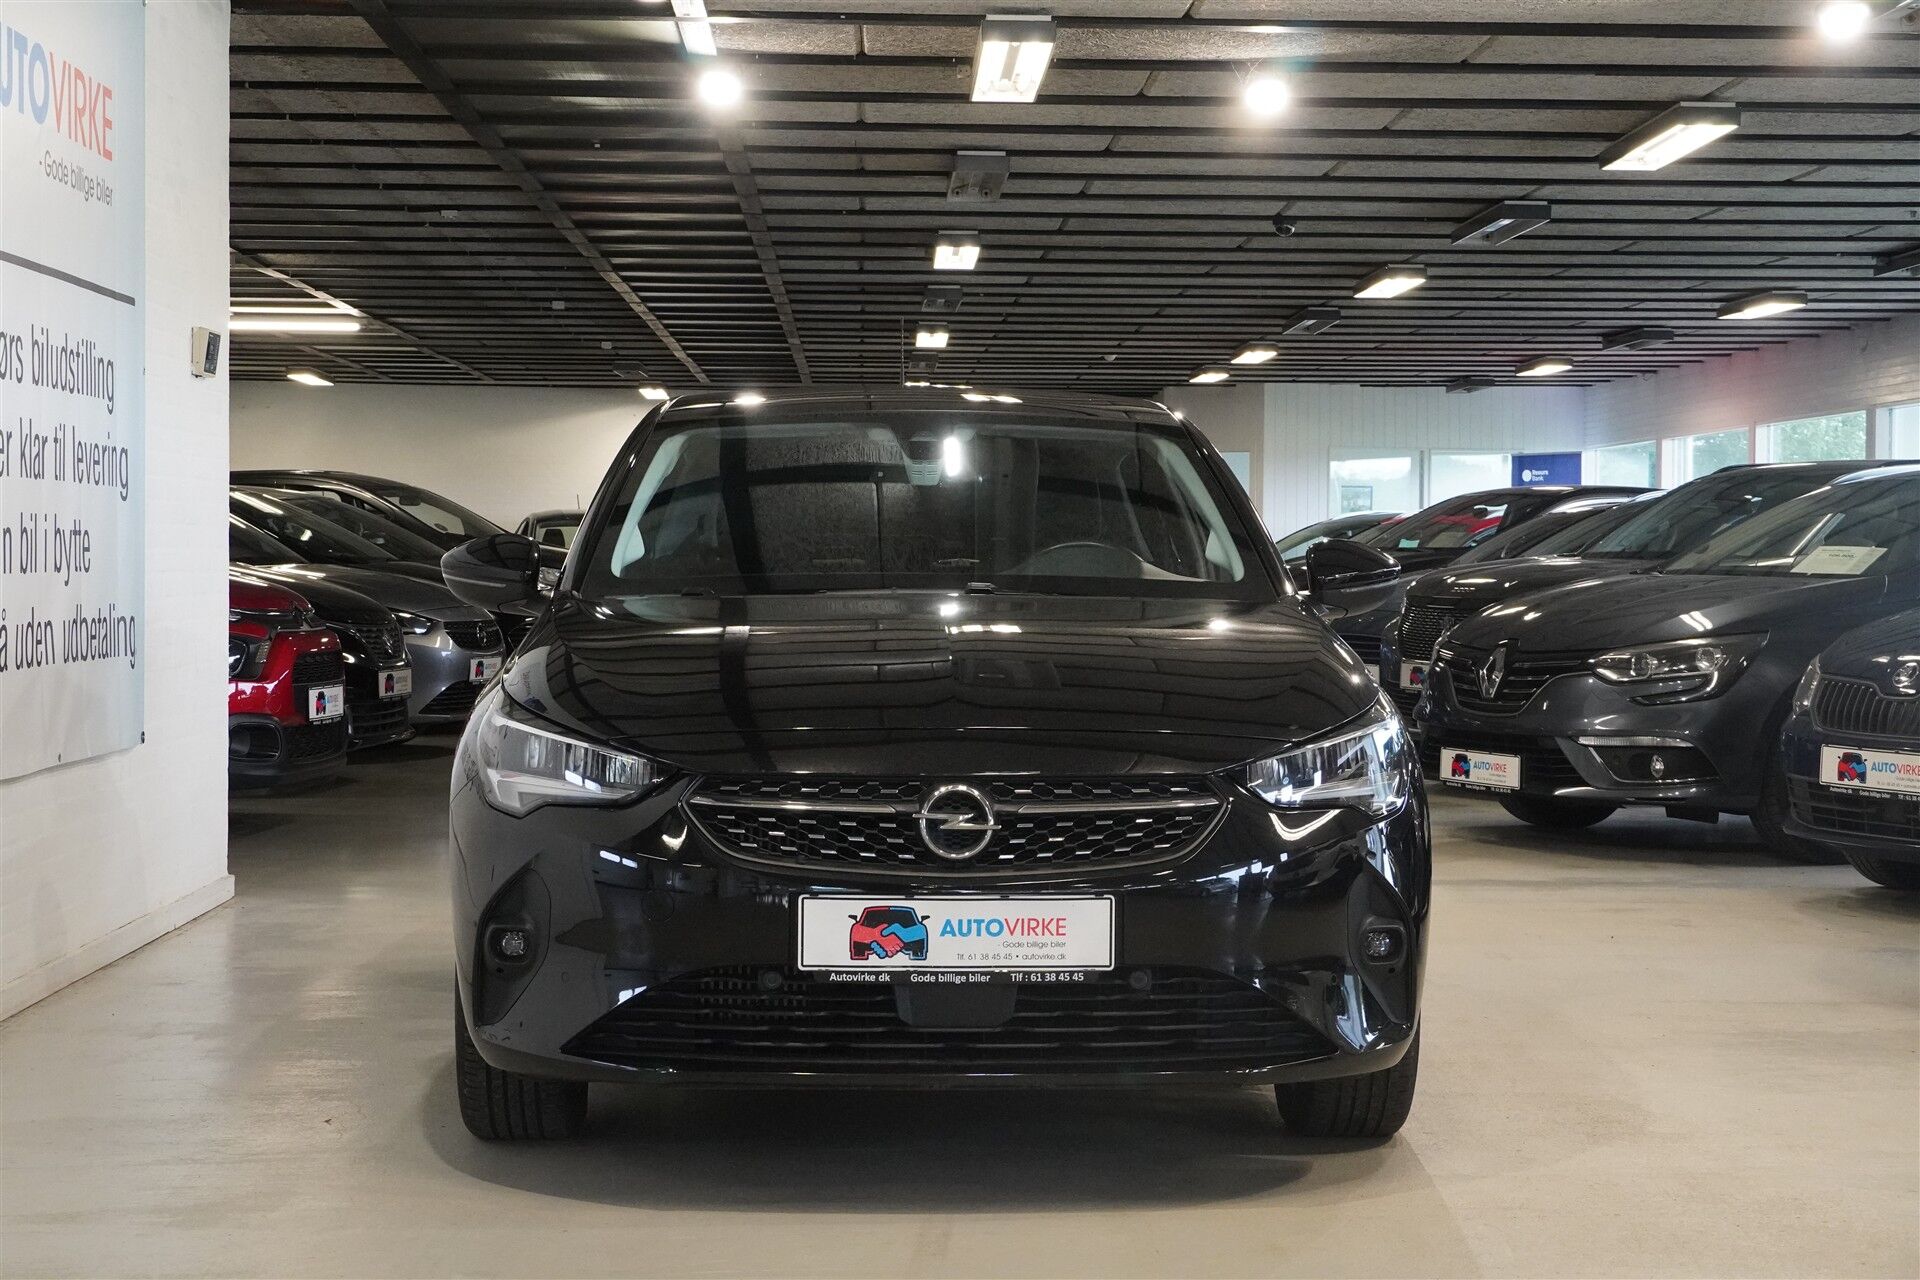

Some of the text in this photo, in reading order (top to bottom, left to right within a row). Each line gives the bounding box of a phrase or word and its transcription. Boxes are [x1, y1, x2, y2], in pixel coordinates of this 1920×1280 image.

[44, 150, 68, 185] Gode
[70, 162, 95, 202] billige
[96, 176, 113, 207] biler
[31, 324, 114, 414] biludstilling
[20, 417, 48, 480] klar
[54, 423, 66, 482] til
[72, 425, 129, 501] levering
[20, 512, 37, 575] bil
[44, 513, 48, 573] i
[54, 512, 91, 586] bytte
[16, 606, 55, 670] uden
[63, 603, 137, 669] udbetaling
[1473, 761, 1507, 773] AUTOVIRKE
[939, 917, 1067, 938] AUTOVIRKE
[1002, 940, 1024, 949] Gode
[1026, 940, 1048, 950] billige
[1050, 940, 1067, 949] biler
[967, 953, 977, 961] 61
[979, 953, 989, 961] 38
[991, 953, 1001, 961] 45
[1003, 953, 1013, 961] 45
[829, 972, 876, 982] Autovirke
[878, 972, 891, 982] dk
[910, 973, 936, 983] Gode
[938, 972, 967, 984] billige
[969, 972, 991, 983] biler
[1010, 972, 1023, 982] Tlf
[1030, 973, 1042, 982] 61
[1044, 973, 1056, 982] 38
[1058, 972, 1071, 982] 45
[1072, 972, 1084, 982] 45
